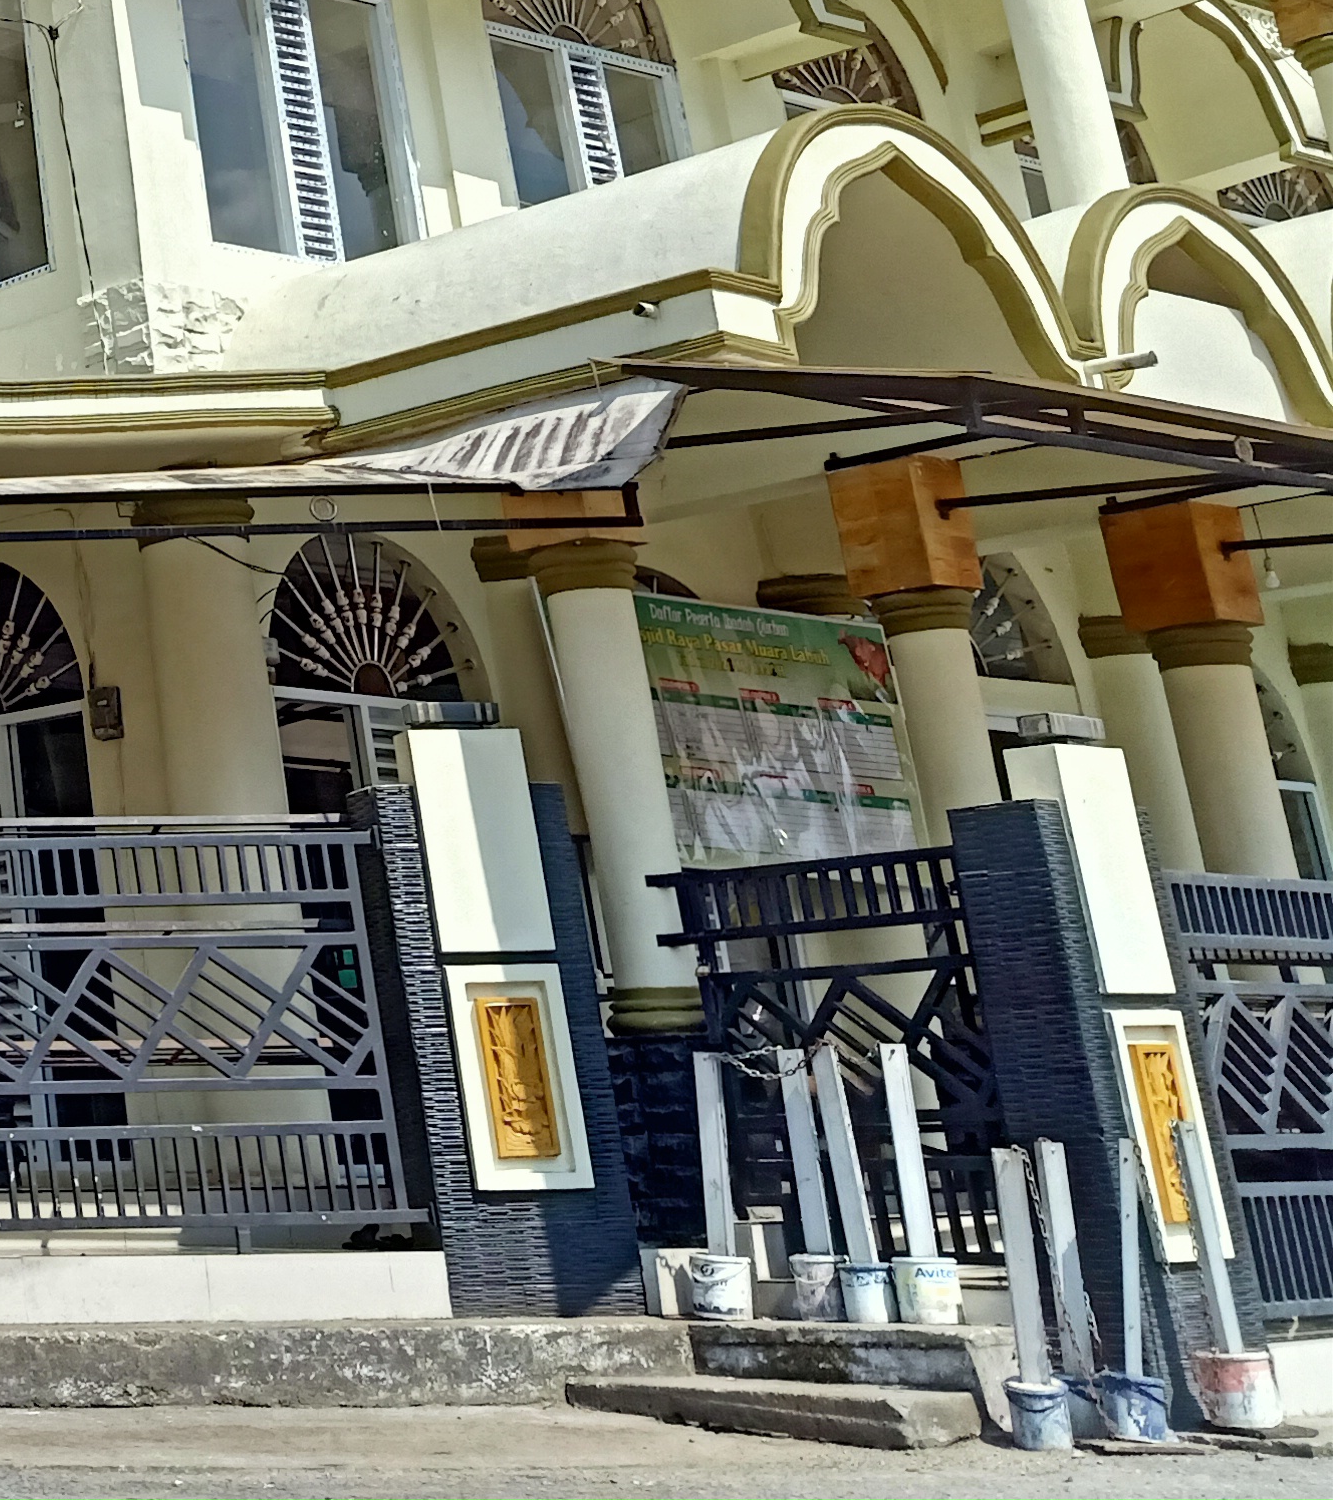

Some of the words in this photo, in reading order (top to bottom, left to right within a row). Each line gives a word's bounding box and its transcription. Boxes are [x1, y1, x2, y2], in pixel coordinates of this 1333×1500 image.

[640, 625, 664, 646] sjid
[666, 628, 701, 650] Raya
[703, 633, 743, 654] Pasar
[790, 644, 831, 666] Labuh
